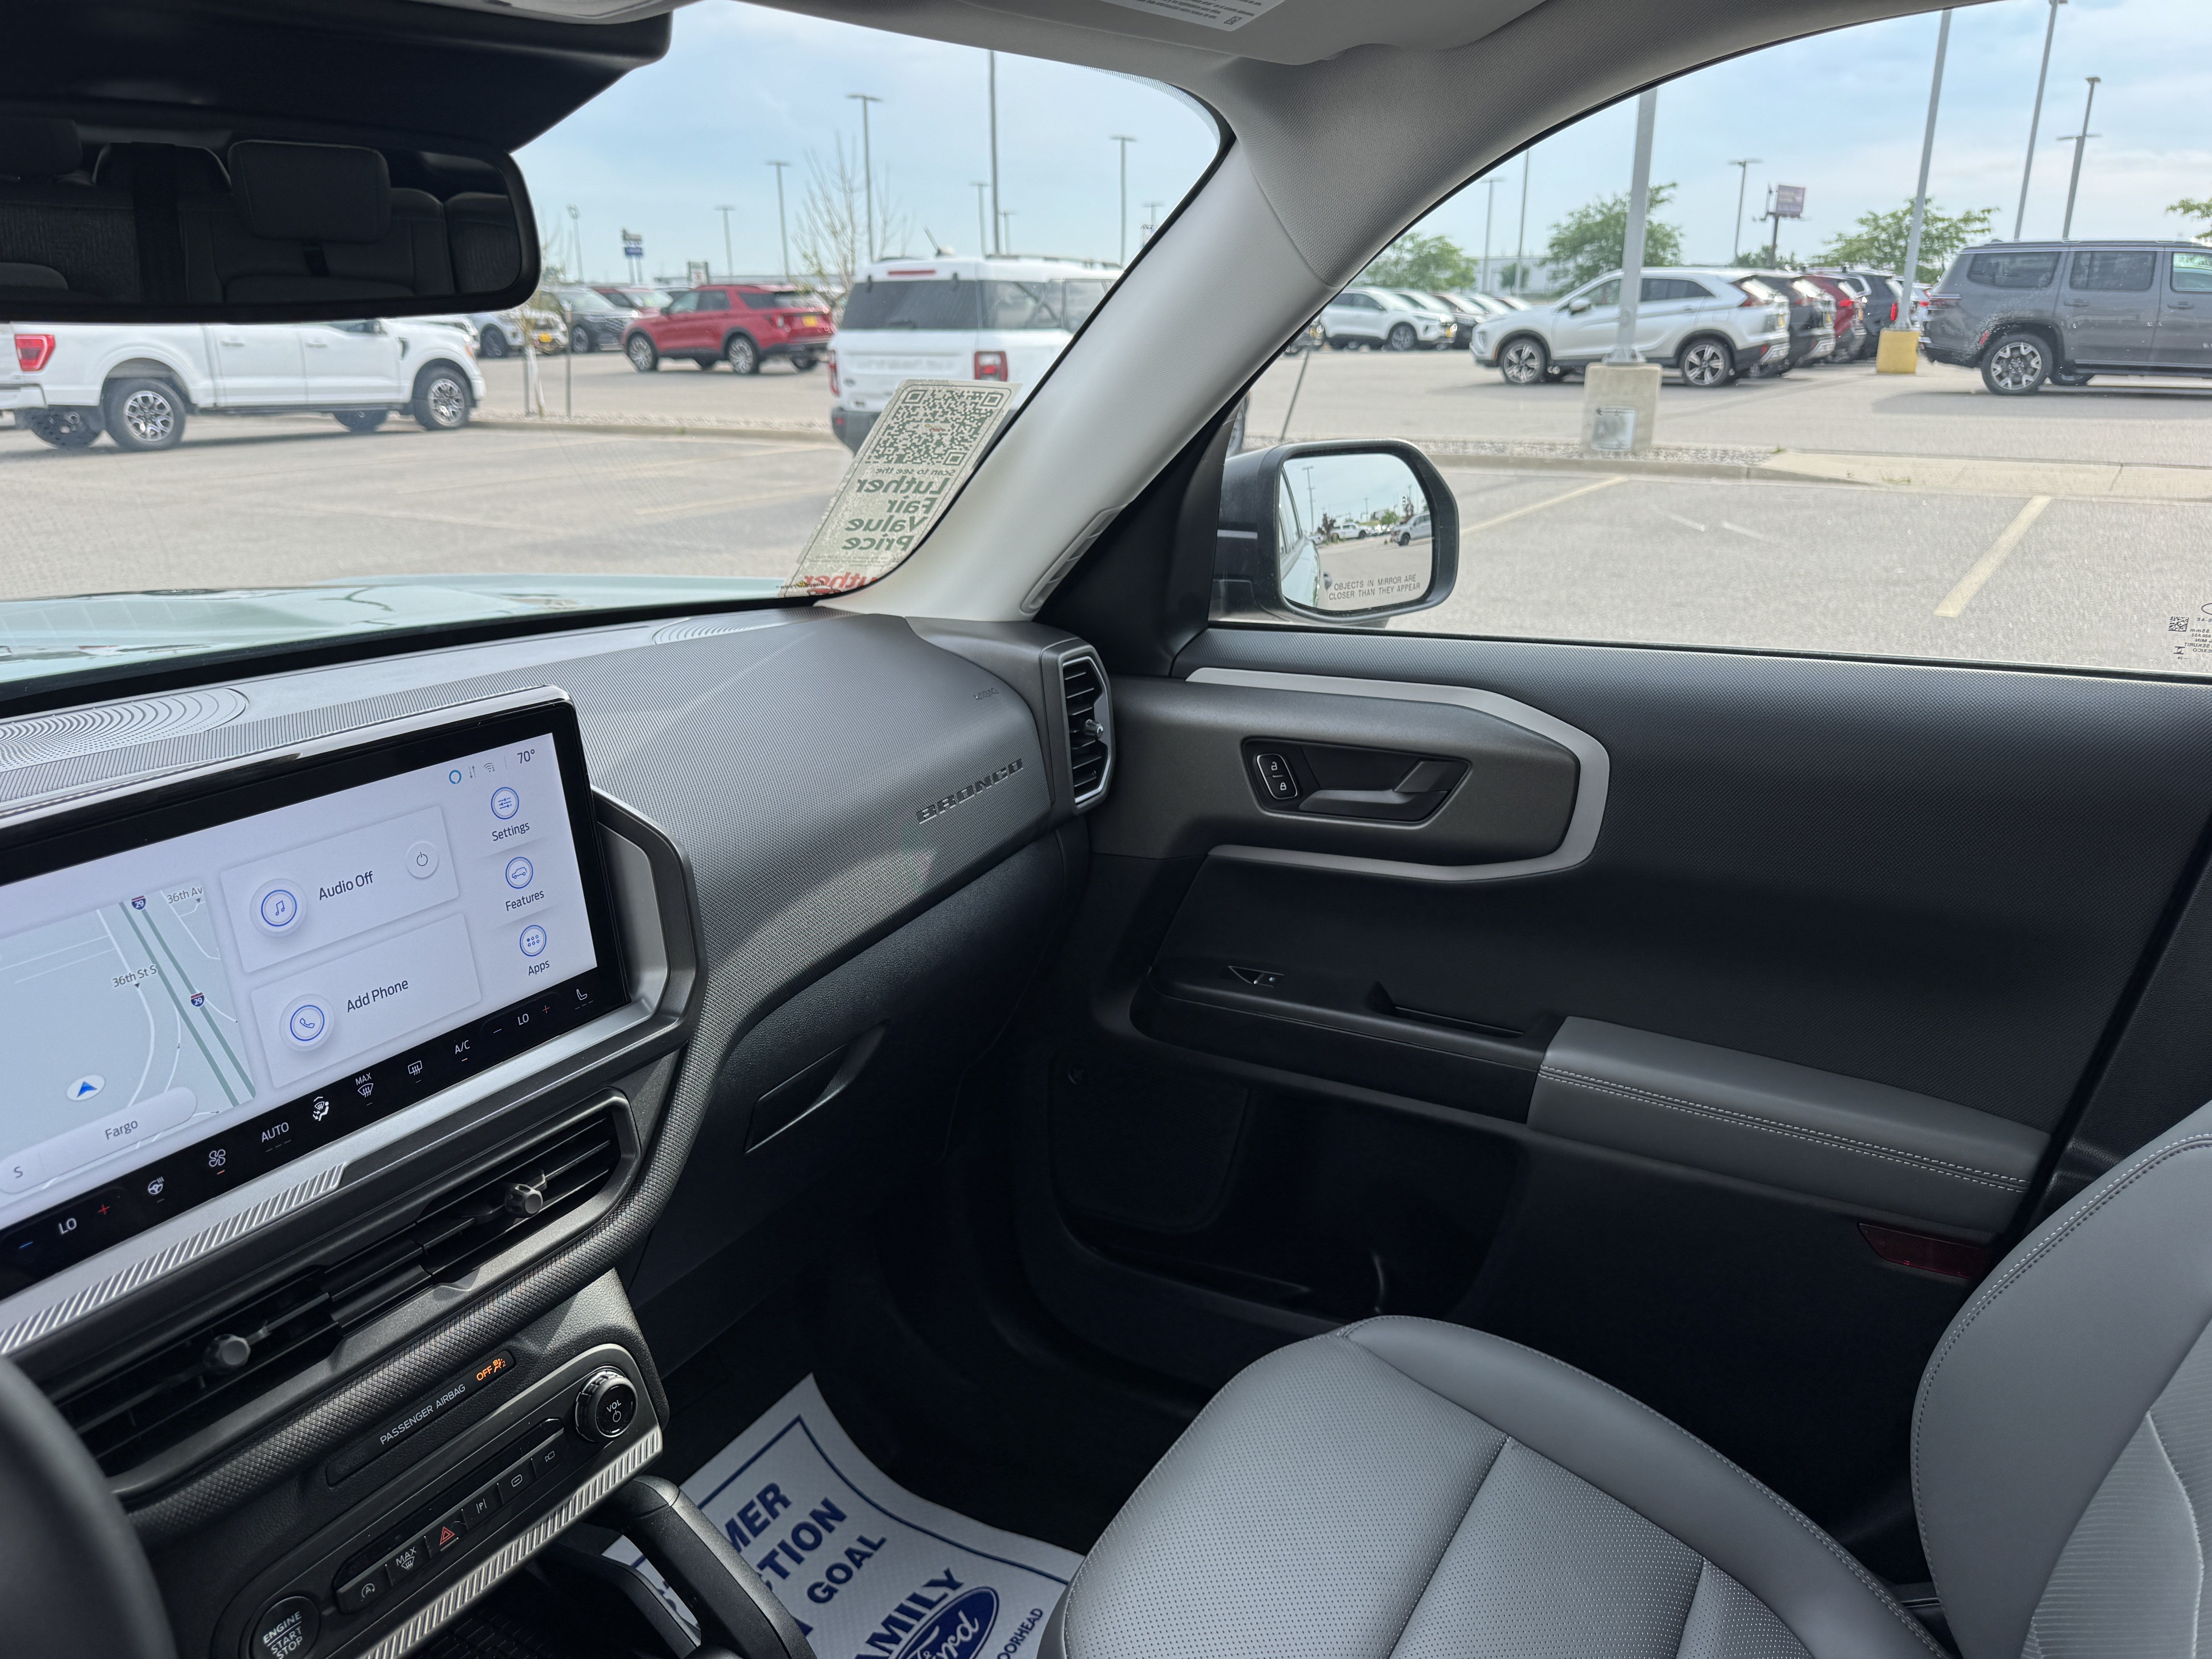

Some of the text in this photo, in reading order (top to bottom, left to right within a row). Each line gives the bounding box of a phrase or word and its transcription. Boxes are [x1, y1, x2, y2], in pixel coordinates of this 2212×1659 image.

[1329, 582, 1420, 601] CLOSER THAN THEY APPEAR
[1334, 574, 1416, 591] OBJECTS IN MIRROR ARE
[517, 749, 535, 764] 70°
[916, 758, 1023, 825] BRONCO
[491, 821, 530, 842] Settings
[167, 887, 203, 904] 36th Av
[318, 870, 374, 901] Audio Off
[135, 900, 144, 908] 29
[505, 890, 545, 912] Features
[112, 965, 157, 988] 36th St S
[527, 959, 550, 976] Apps
[194, 997, 203, 1006] 29
[346, 979, 409, 1013] Add Phone
[517, 1013, 529, 1026] LO
[454, 1039, 471, 1054] A/C
[355, 1073, 372, 1085] MAX
[105, 1120, 139, 1140] Fargo
[261, 1121, 290, 1143] AUTO
[58, 1218, 77, 1235] LO
[476, 1365, 493, 1381] OFF
[380, 1384, 466, 1445] PASSENGER AIRBAG
[606, 1400, 622, 1413] VOL
[755, 1497, 847, 1590] TION
[396, 1546, 417, 1566] MAX
[807, 1534, 887, 1604] GOAL
[854, 1567, 964, 1659] MILY
[263, 1611, 302, 1644] ENGINE
[271, 1626, 302, 1654] START
[276, 1636, 303, 1659] STOP
